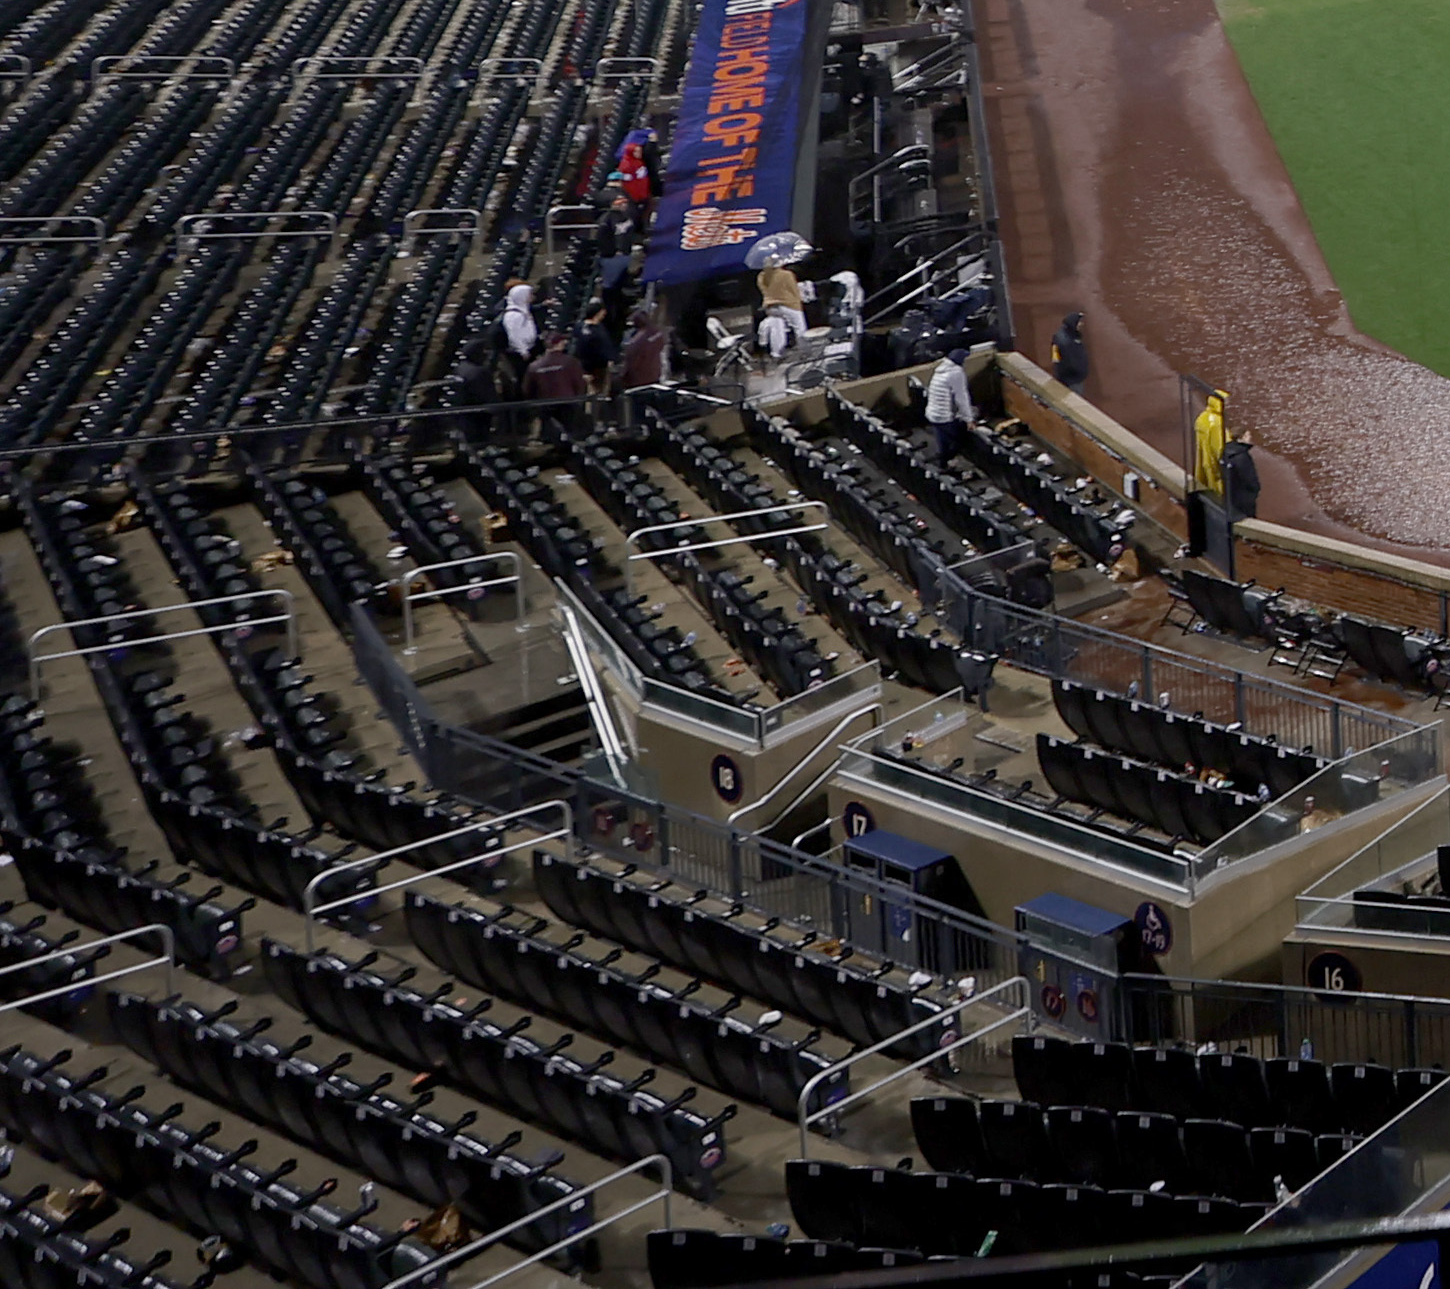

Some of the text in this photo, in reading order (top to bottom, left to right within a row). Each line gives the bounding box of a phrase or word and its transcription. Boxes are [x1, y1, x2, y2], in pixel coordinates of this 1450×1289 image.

[720, 11, 773, 49] FIELD
[707, 47, 770, 114] HOME
[702, 112, 763, 147] OF
[691, 147, 758, 206] THE
[1324, 967, 1345, 991] 16
